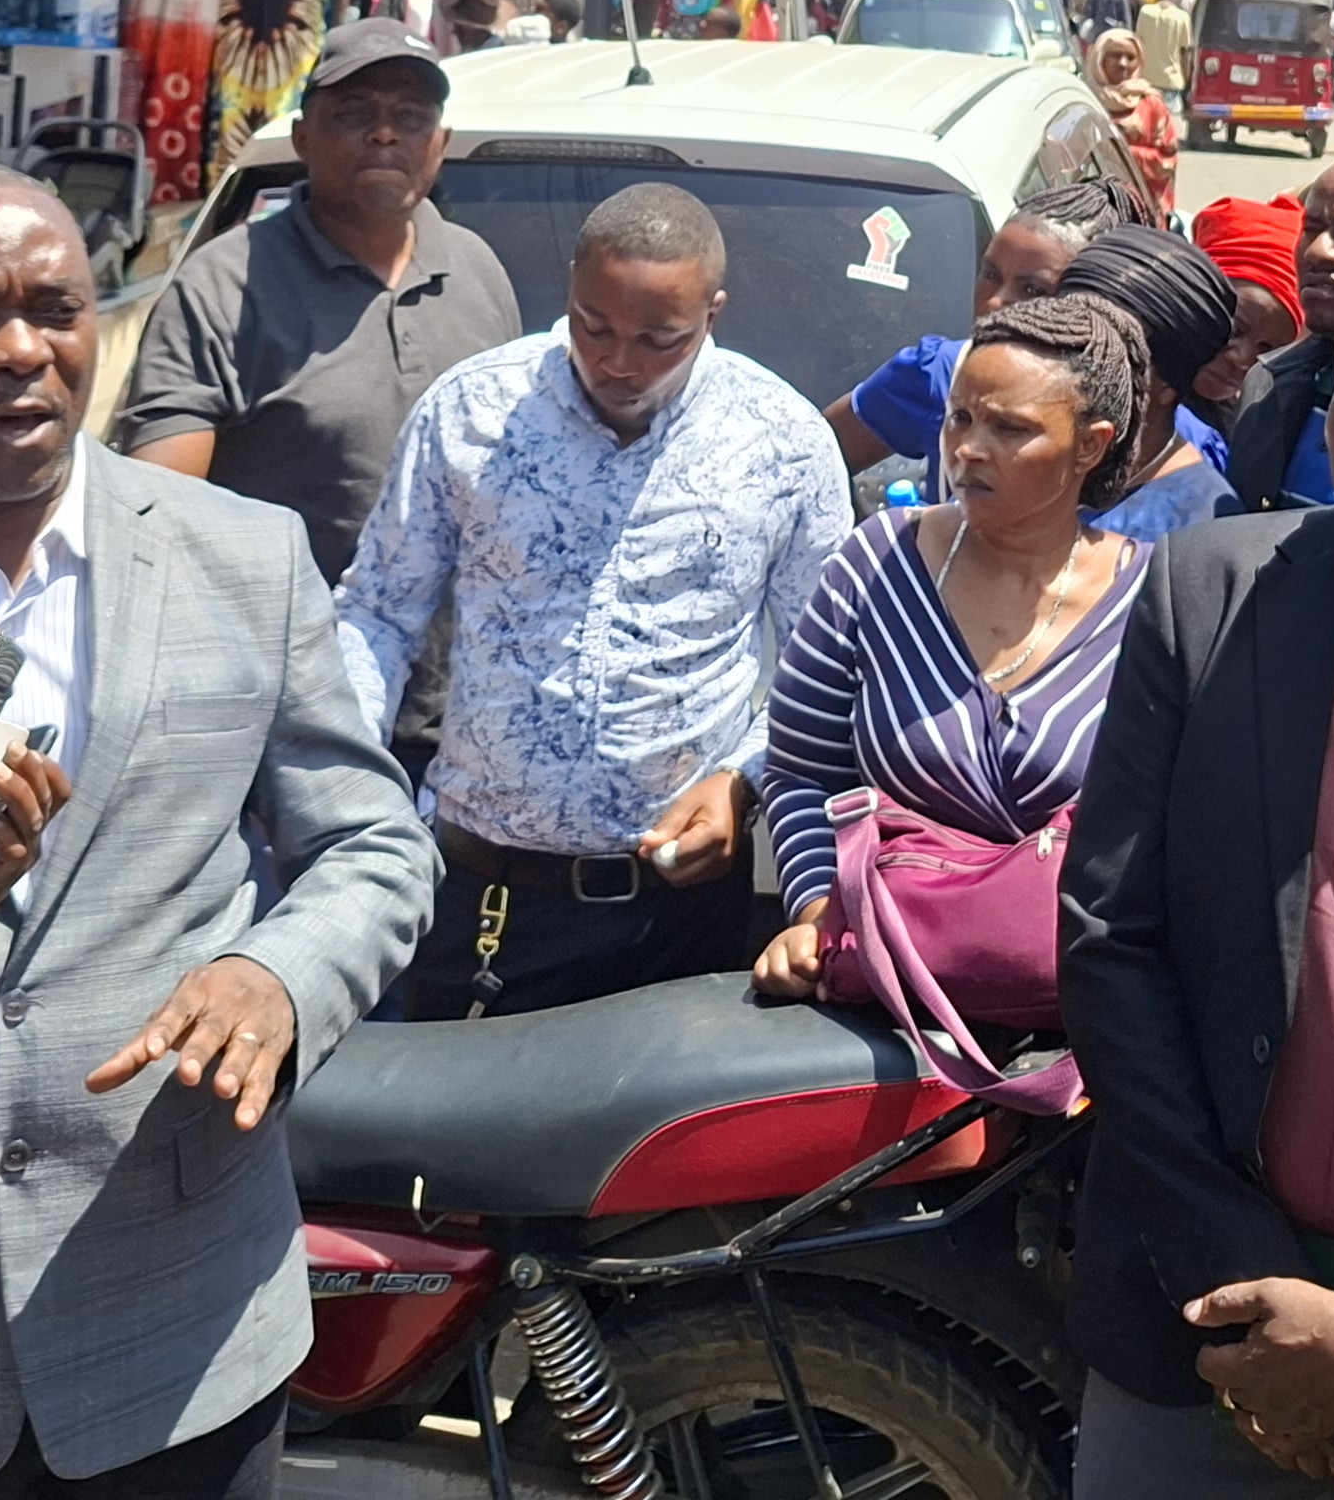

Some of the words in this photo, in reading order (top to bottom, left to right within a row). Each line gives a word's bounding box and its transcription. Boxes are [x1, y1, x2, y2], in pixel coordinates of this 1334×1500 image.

[850, 266, 903, 285] PALESTINE
[867, 262, 891, 273] FREE
[369, 1273, 452, 1294] 150
